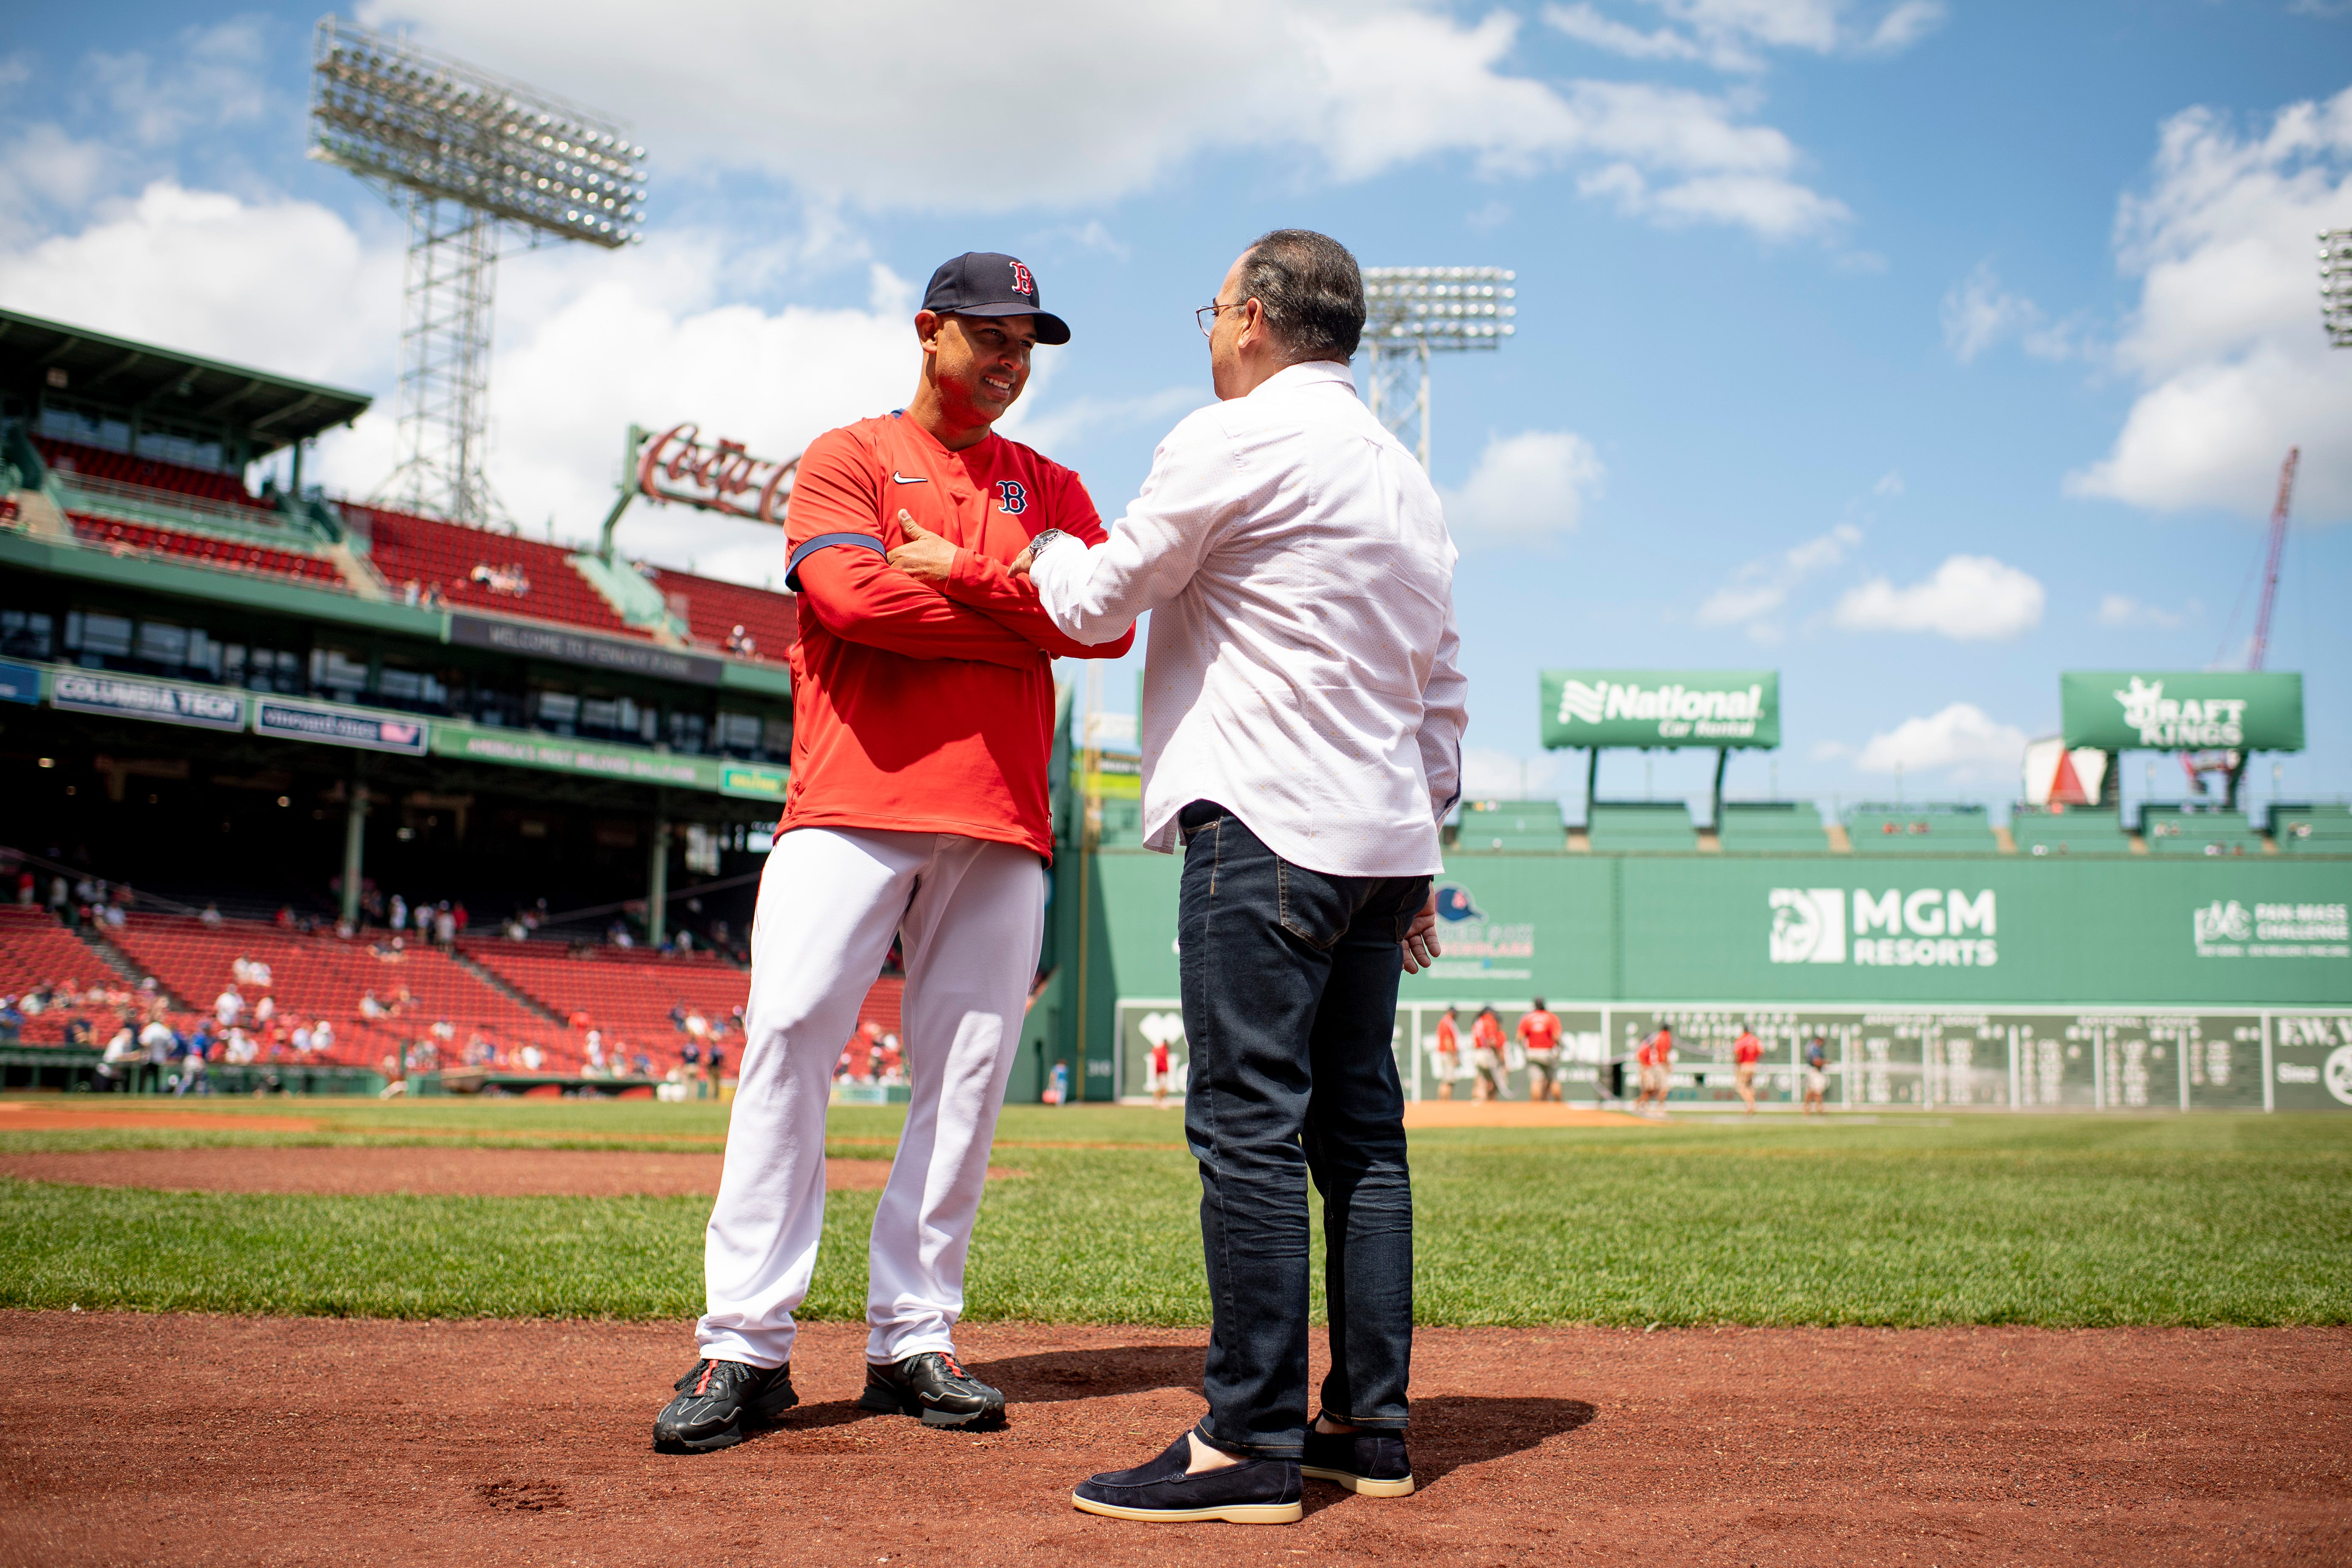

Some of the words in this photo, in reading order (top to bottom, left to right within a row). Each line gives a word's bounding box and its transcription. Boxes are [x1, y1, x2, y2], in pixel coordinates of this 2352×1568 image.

[1009, 261, 1033, 296] B
[996, 479, 1029, 515] B
[57, 676, 177, 712] COLUMBIA
[177, 691, 236, 720] TECH
[1606, 683, 1762, 720] National
[1658, 720, 1692, 738] Car
[1694, 720, 1756, 738] Rental
[2140, 723, 2244, 746] KINGS
[1853, 888, 1996, 936] MGM
[2254, 903, 2348, 922] PAN-MASS
[2256, 922, 2349, 941] CHALLENGE
[1854, 939, 1998, 966] RESORTS
